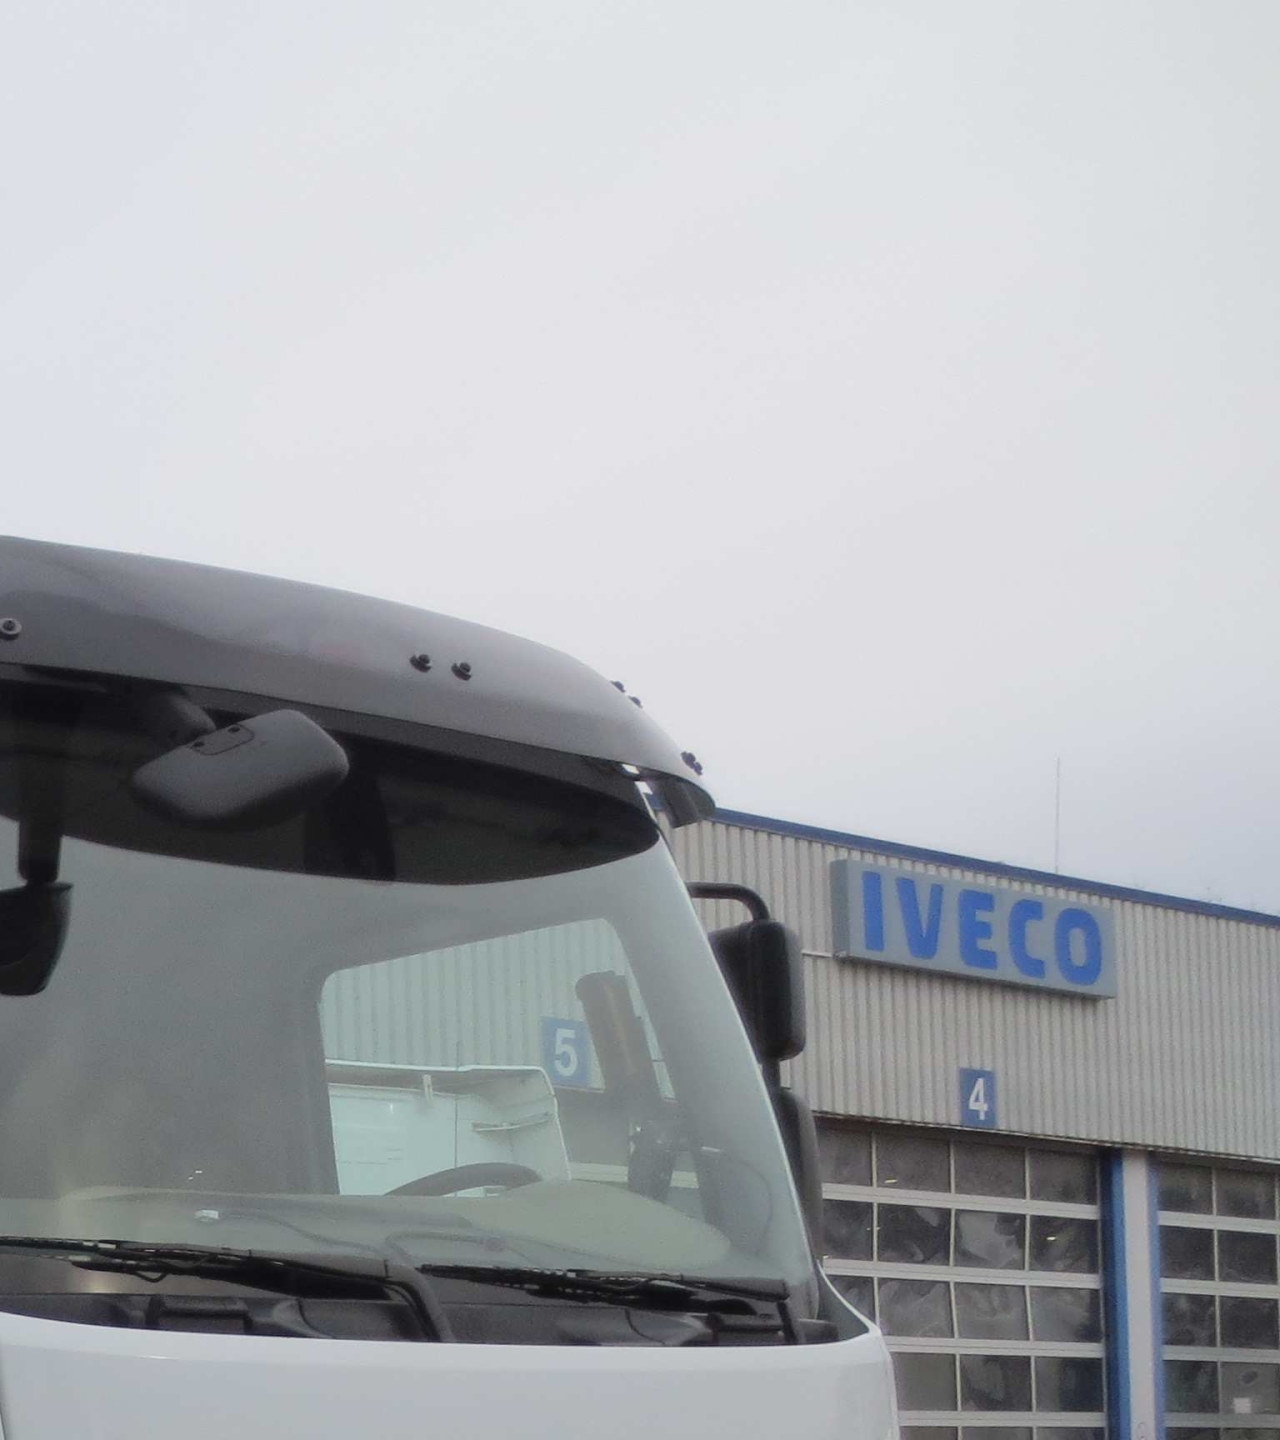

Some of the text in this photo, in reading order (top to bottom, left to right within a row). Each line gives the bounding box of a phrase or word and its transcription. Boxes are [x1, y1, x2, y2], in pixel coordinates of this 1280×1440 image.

[861, 870, 1103, 986] IVECO
[554, 1027, 578, 1077] 5
[968, 1077, 988, 1121] 4
